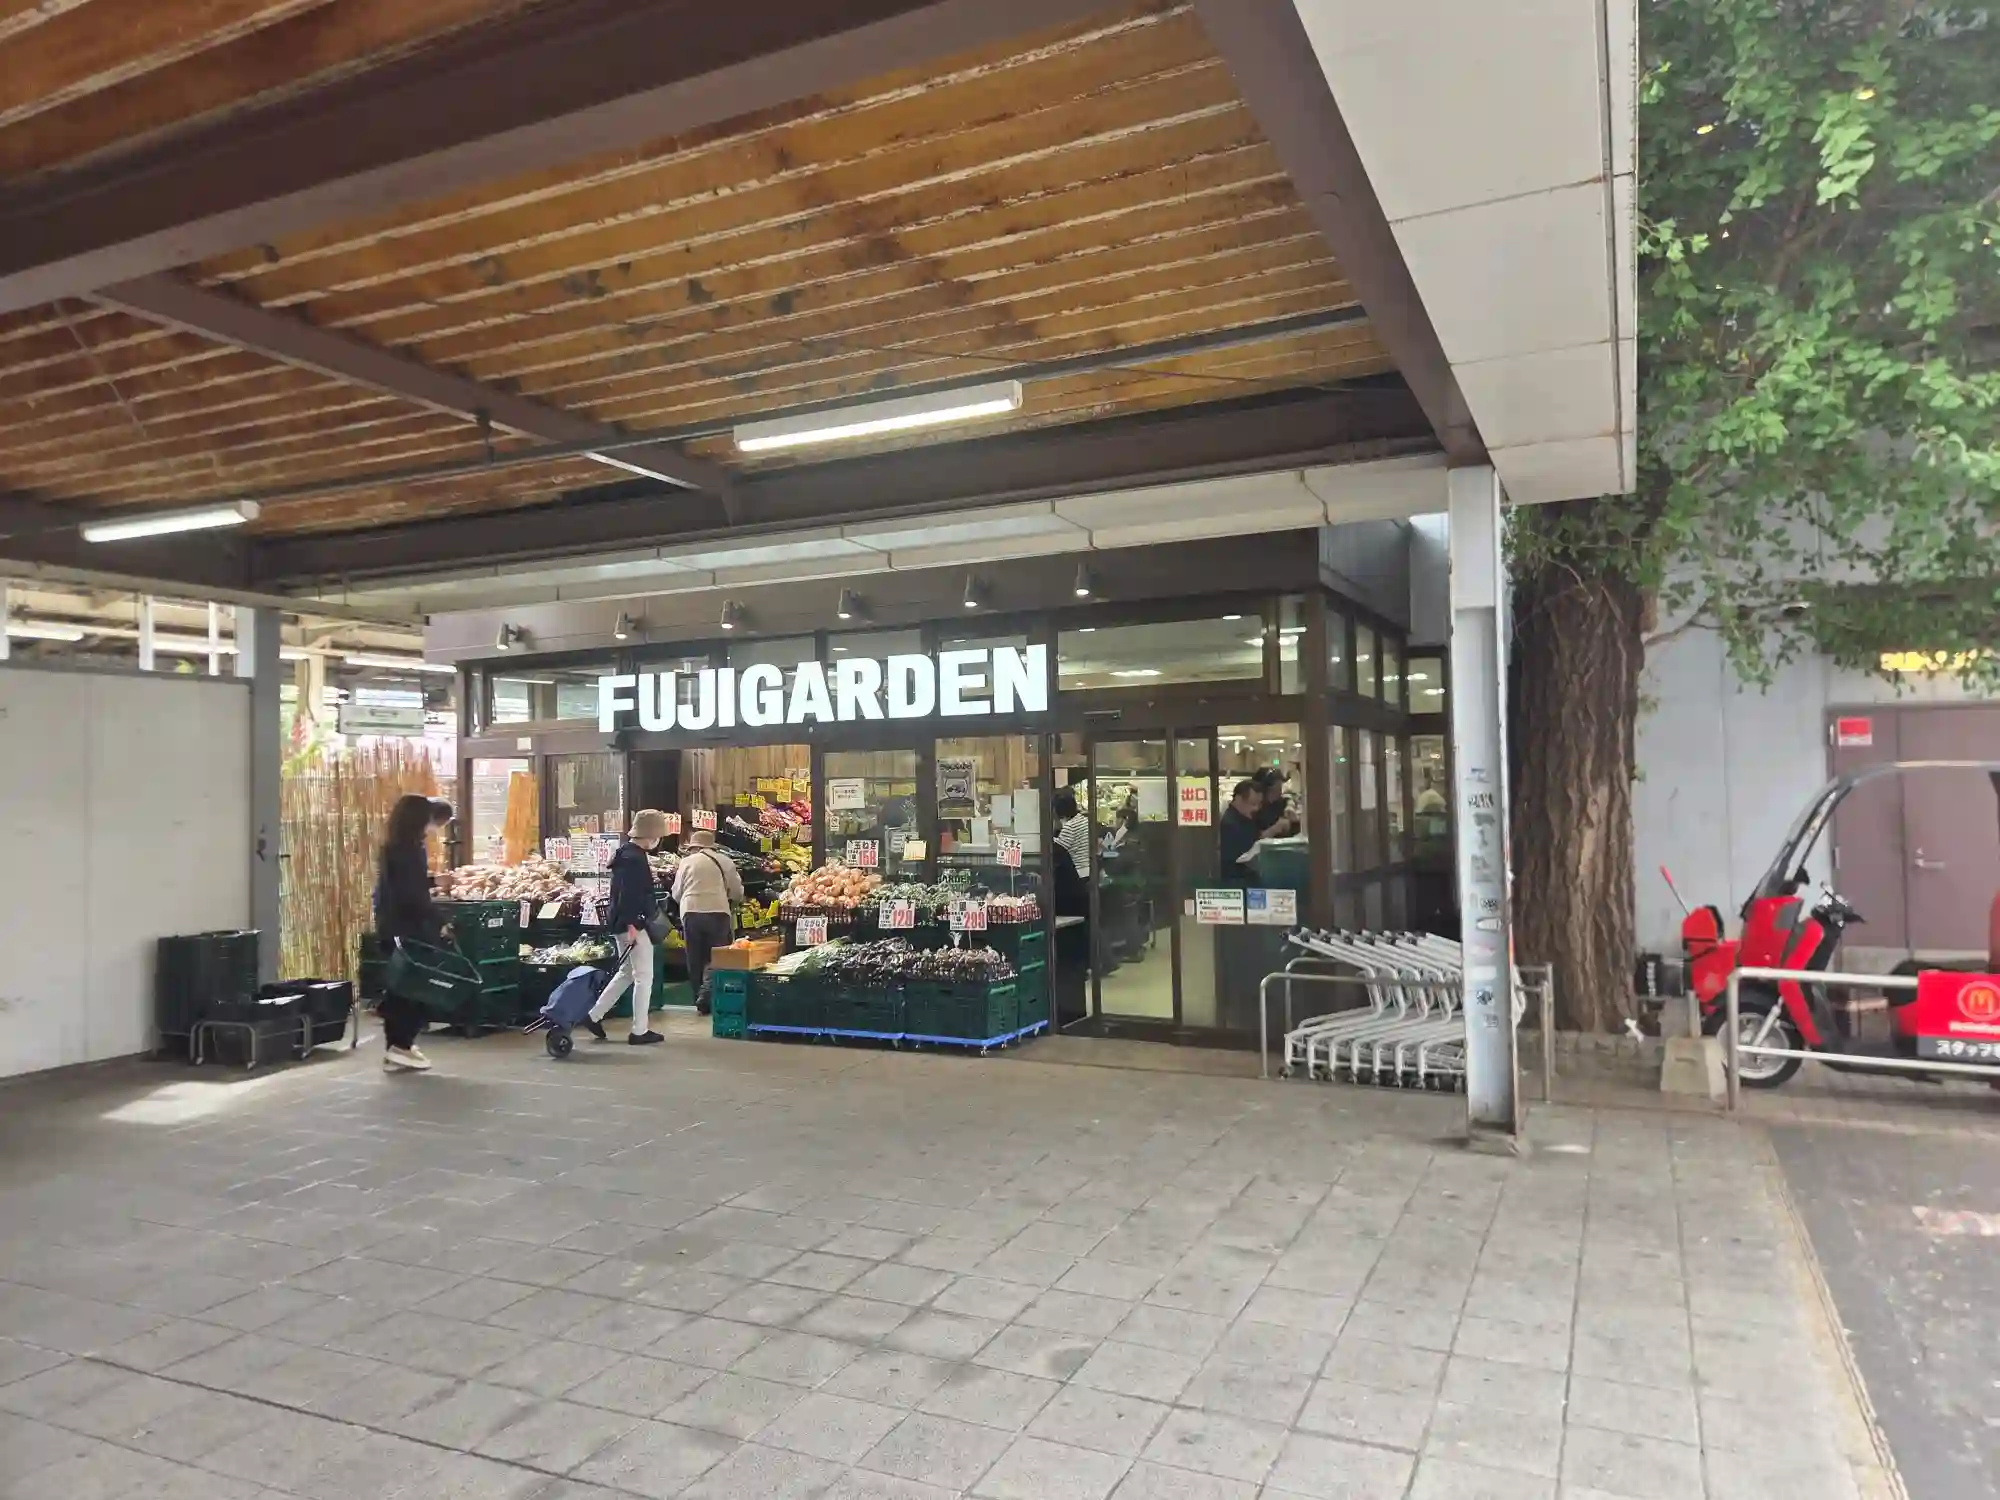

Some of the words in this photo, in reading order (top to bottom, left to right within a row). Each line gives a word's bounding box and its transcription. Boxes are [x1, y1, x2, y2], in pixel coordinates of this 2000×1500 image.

[599, 644, 1048, 733] FUJIGARDEN
[1181, 787, 1207, 801] 出口
[1181, 808, 1207, 822] 専用
